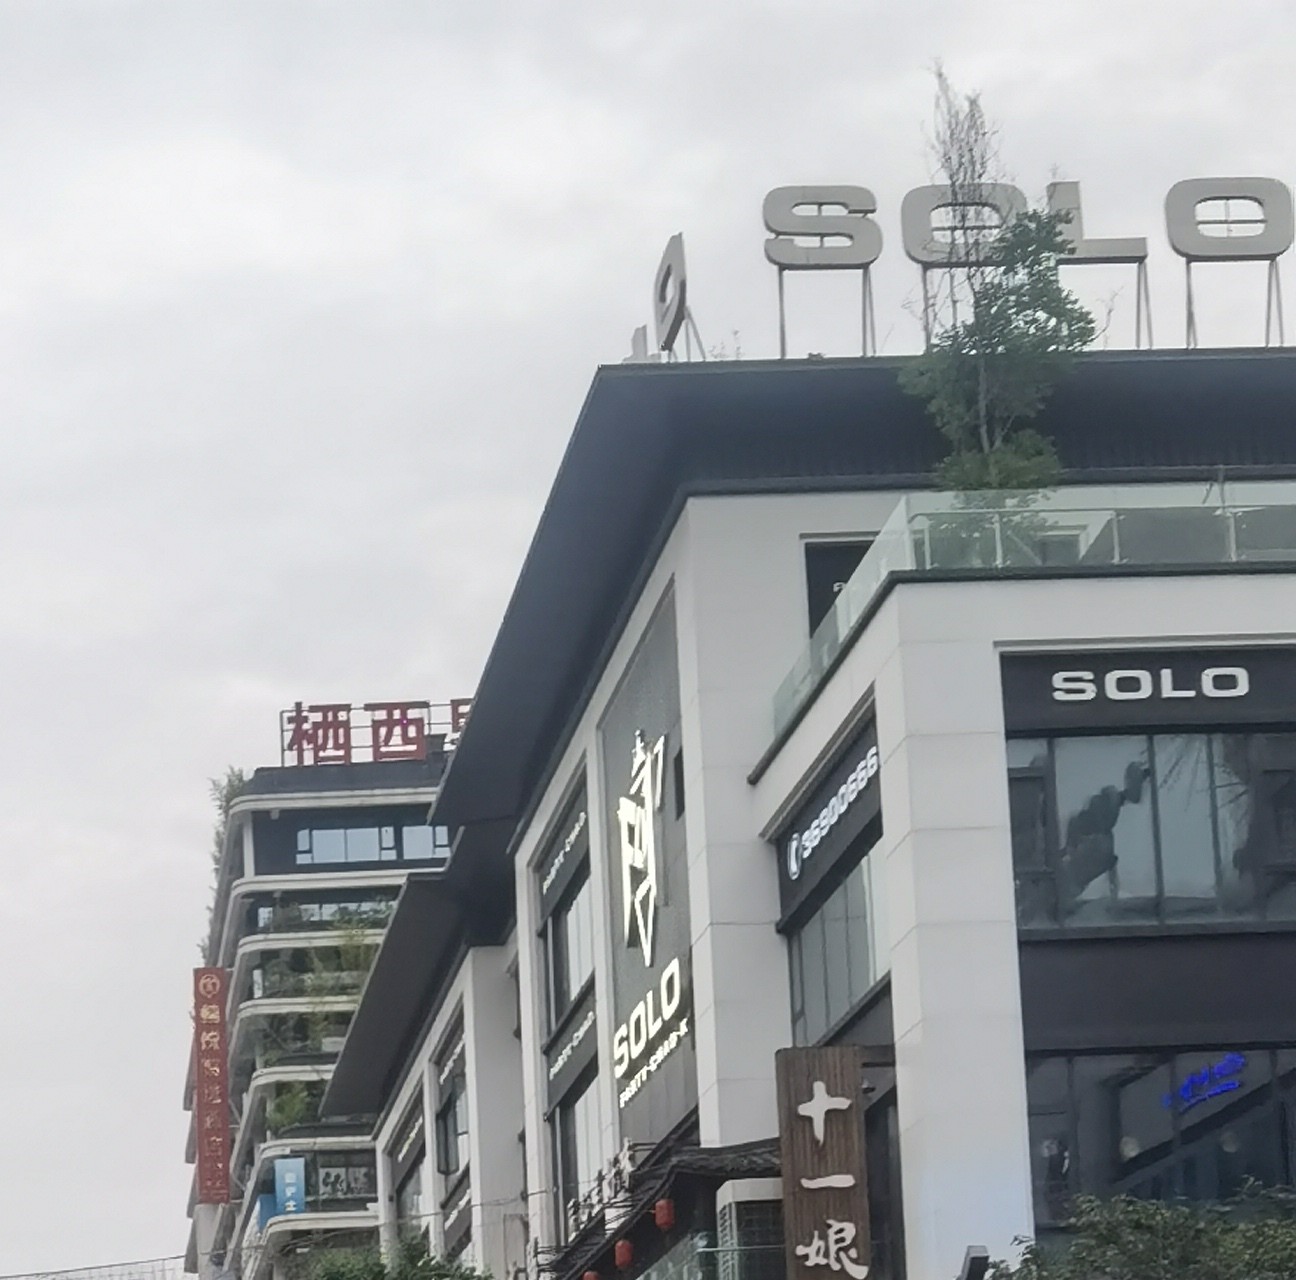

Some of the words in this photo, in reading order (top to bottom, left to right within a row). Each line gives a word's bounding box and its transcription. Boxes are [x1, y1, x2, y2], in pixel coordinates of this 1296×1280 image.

[762, 176, 1295, 270] SOLO
[1051, 667, 1250, 701] SOLO
[613, 957, 681, 1079] SOLO
[796, 1080, 869, 1280] 十一娘
